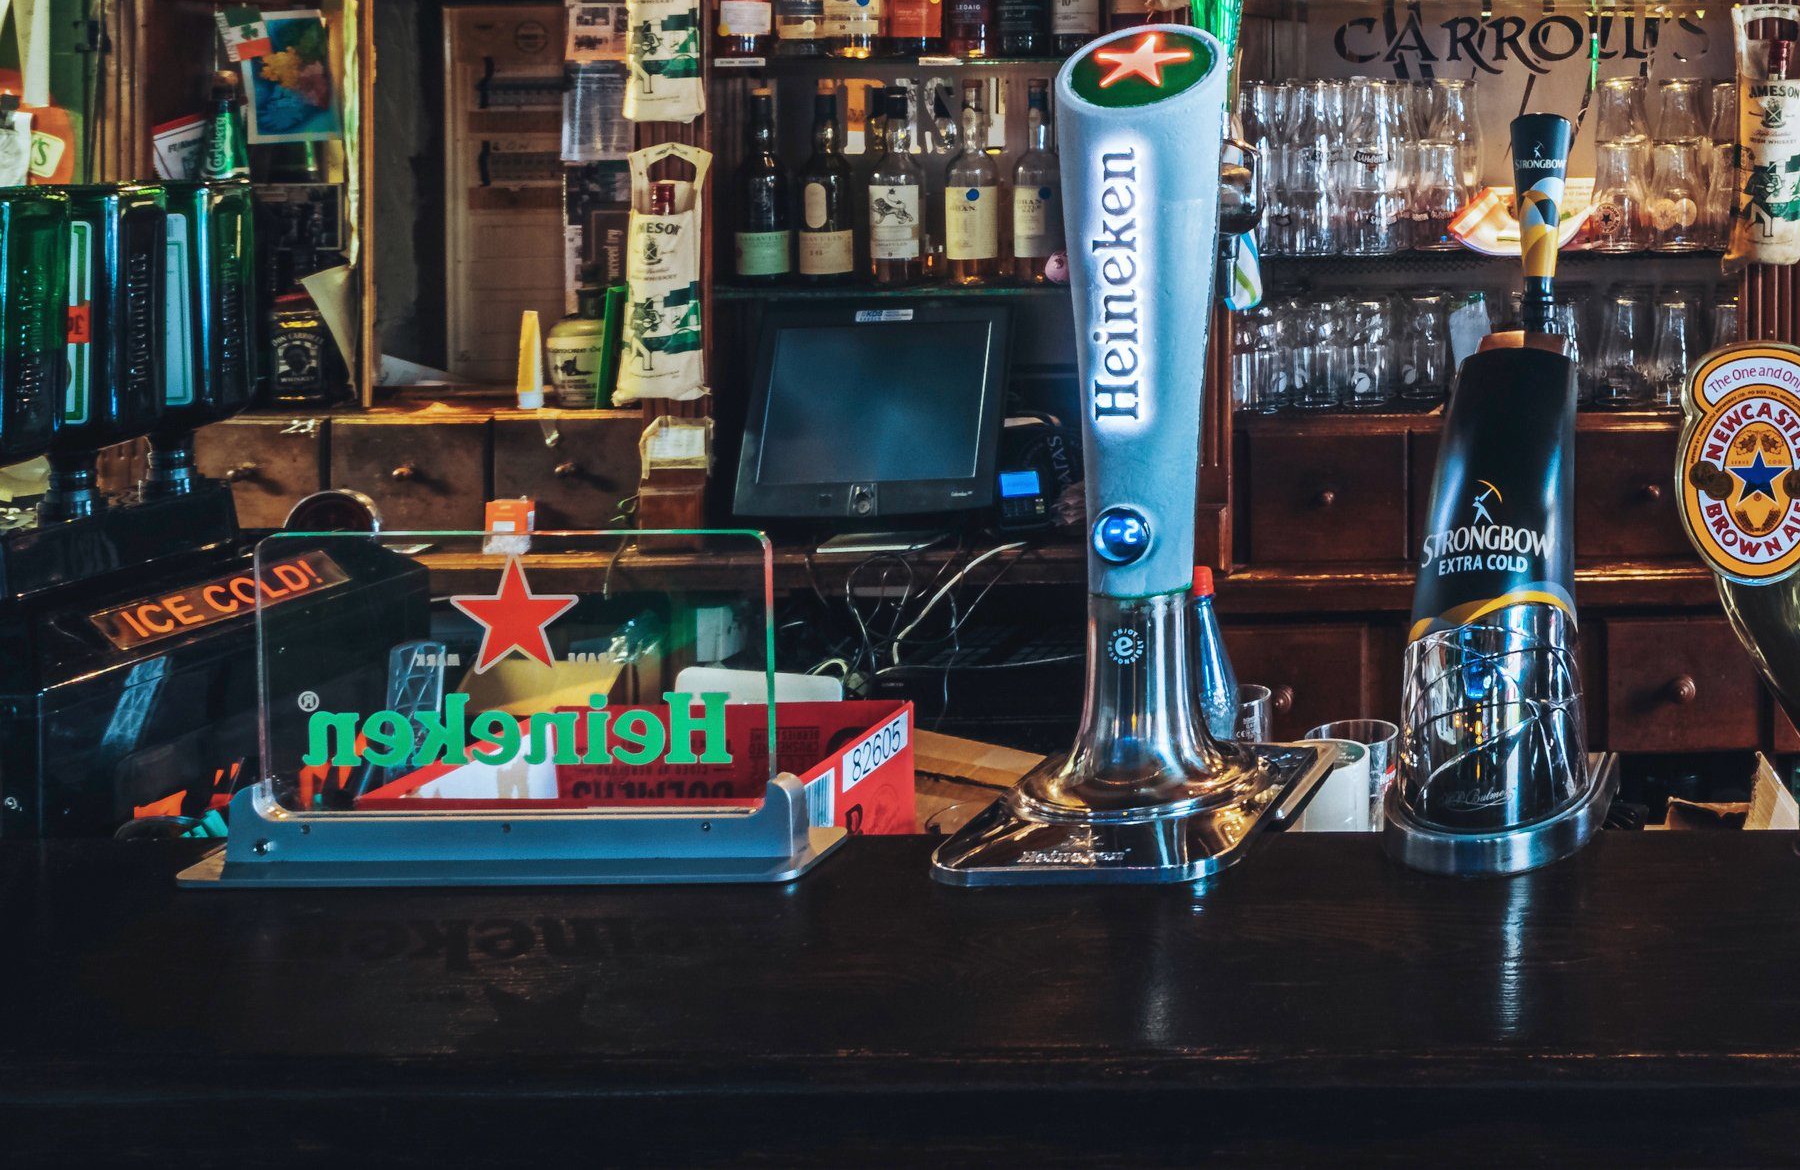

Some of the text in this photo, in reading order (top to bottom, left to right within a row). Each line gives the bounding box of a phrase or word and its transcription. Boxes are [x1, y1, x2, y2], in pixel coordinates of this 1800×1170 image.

[206, 116, 227, 172] Carlsberg
[1515, 156, 1567, 171] STRONGBOW
[1092, 146, 1141, 421] Heineken
[1708, 374, 1731, 394] The
[1732, 365, 1757, 382] One
[1758, 366, 1783, 380] and
[1421, 523, 1555, 569] STRONGBOW
[1705, 502, 1783, 558] BROWN
[1438, 554, 1529, 576] EXTRA COLD
[120, 559, 325, 639] ICE COLD!
[851, 718, 902, 782] 82605
[1016, 850, 1124, 865] Heineken
